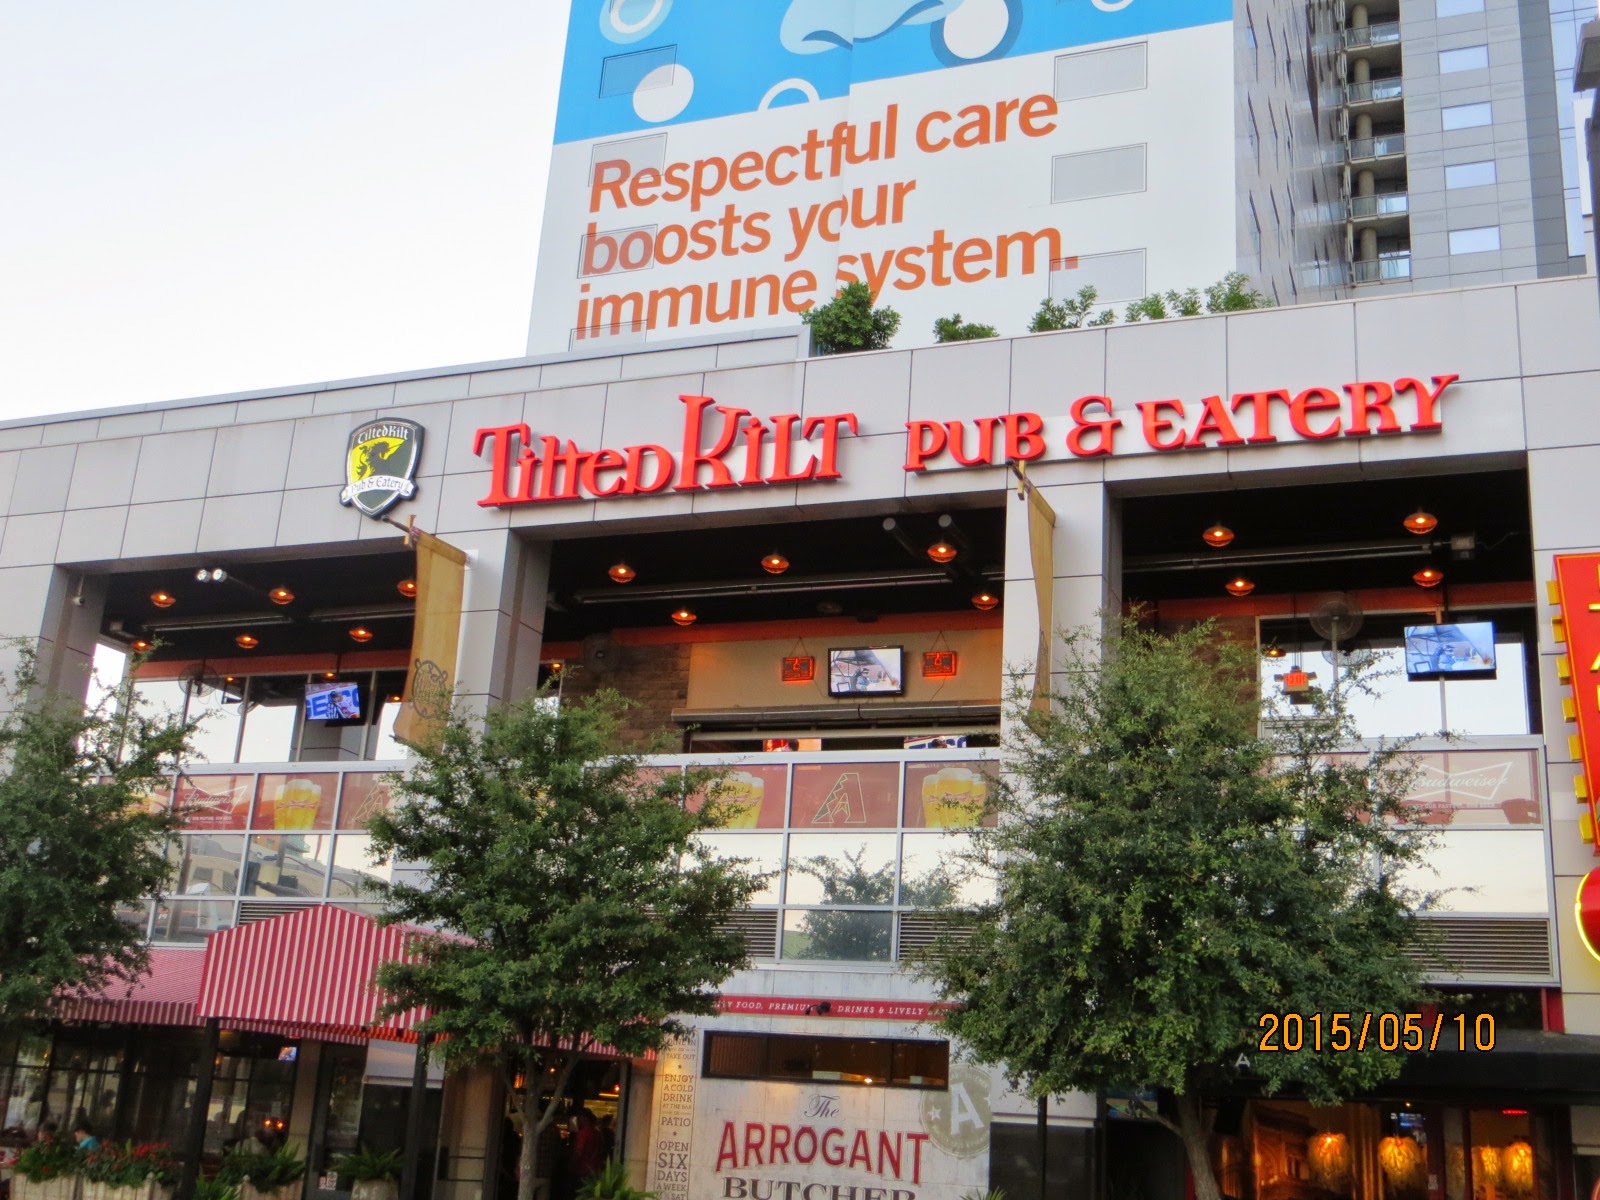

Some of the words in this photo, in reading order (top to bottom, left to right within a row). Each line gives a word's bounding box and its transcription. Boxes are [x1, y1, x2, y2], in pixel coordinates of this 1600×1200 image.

[589, 105, 897, 213] Respectful
[915, 94, 1057, 153] care
[582, 204, 770, 276] boosts
[784, 179, 916, 262] your
[575, 268, 818, 340] immune
[835, 227, 1079, 306] system.
[903, 411, 1047, 473] PUB
[1065, 394, 1122, 458] &
[1136, 373, 1460, 451] EATERY
[736, 1001, 764, 1010] FOOD,
[838, 1005, 875, 1014] DRINKS
[879, 1006, 884, 1014] &
[889, 1007, 924, 1016] LIVELY
[664, 1073, 694, 1084] ENJOY
[664, 1083, 669, 1092] A
[670, 1084, 694, 1093] COLD
[662, 1093, 693, 1103] DRINK
[804, 1094, 840, 1118] The
[950, 1081, 985, 1136] A
[661, 1116, 691, 1127] PATIO
[659, 1140, 689, 1152] OPEN
[715, 1121, 929, 1185] ARROGANT
[657, 1152, 688, 1170] SIX
[657, 1169, 688, 1183] DAYS
[656, 1182, 662, 1190] A
[663, 1182, 687, 1192] WEEK
